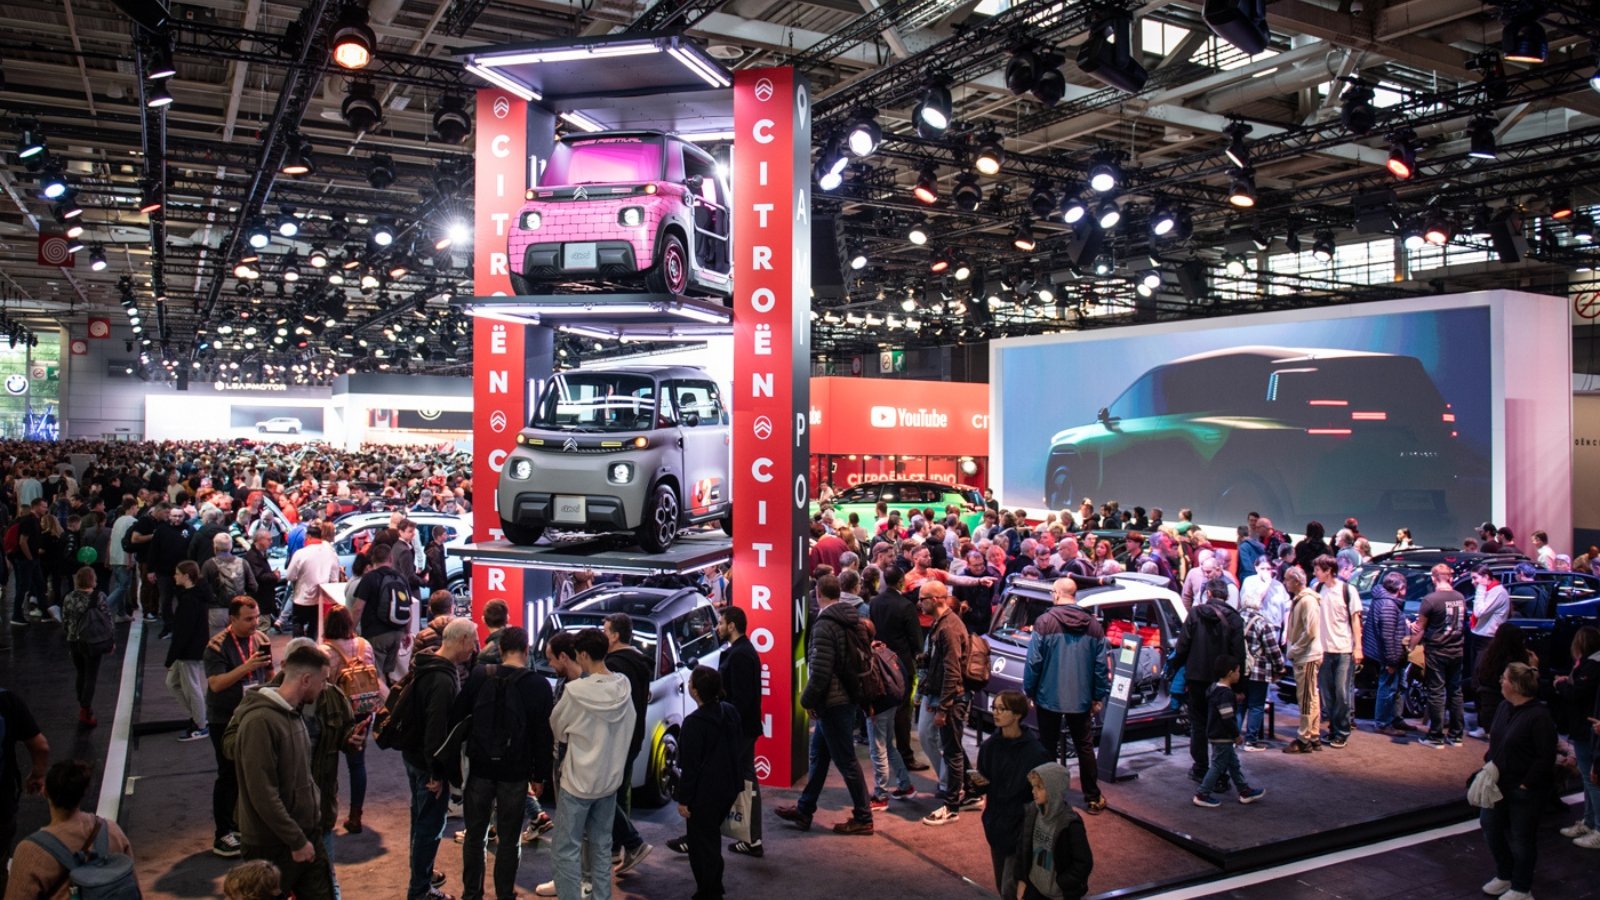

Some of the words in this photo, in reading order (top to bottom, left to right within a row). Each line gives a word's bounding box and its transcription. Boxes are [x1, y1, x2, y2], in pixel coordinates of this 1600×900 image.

[225, 382, 287, 391] LEAPMOTOR
[489, 135, 510, 394] CITRËN
[751, 118, 775, 398] CITROËN
[897, 408, 948, 428] YouTube
[795, 412, 806, 693] POINT
